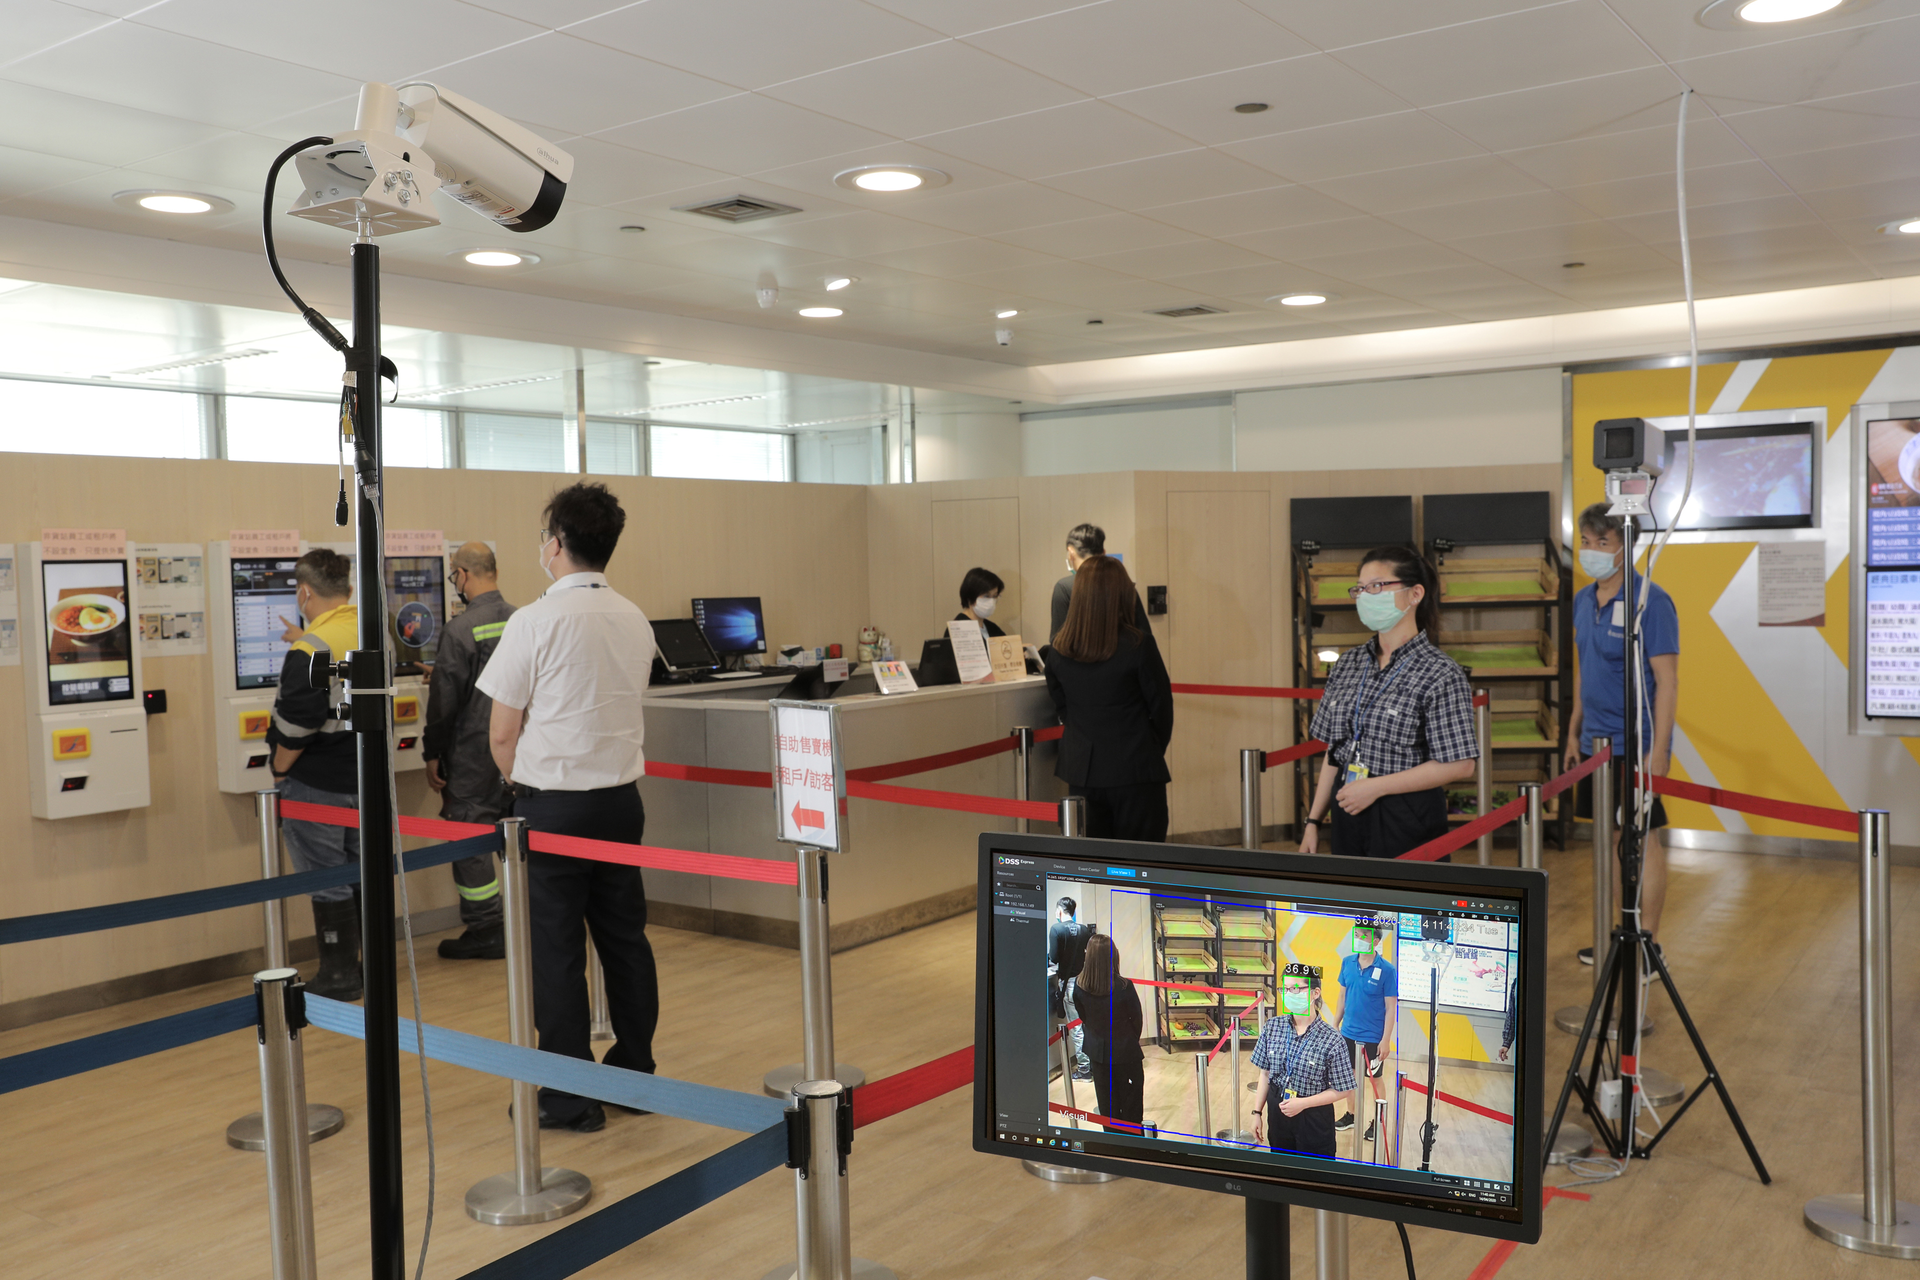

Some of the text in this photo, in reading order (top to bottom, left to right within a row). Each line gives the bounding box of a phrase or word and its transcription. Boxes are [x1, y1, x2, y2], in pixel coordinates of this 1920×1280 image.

[1871, 573, 1920, 584] 經典自選車
[778, 733, 833, 757] 自助售賣機
[780, 766, 834, 792] 租戶/訪客
[1005, 858, 1020, 866] DSS
[1476, 924, 1499, 935] Tue
[1059, 1109, 1088, 1122] Visual
